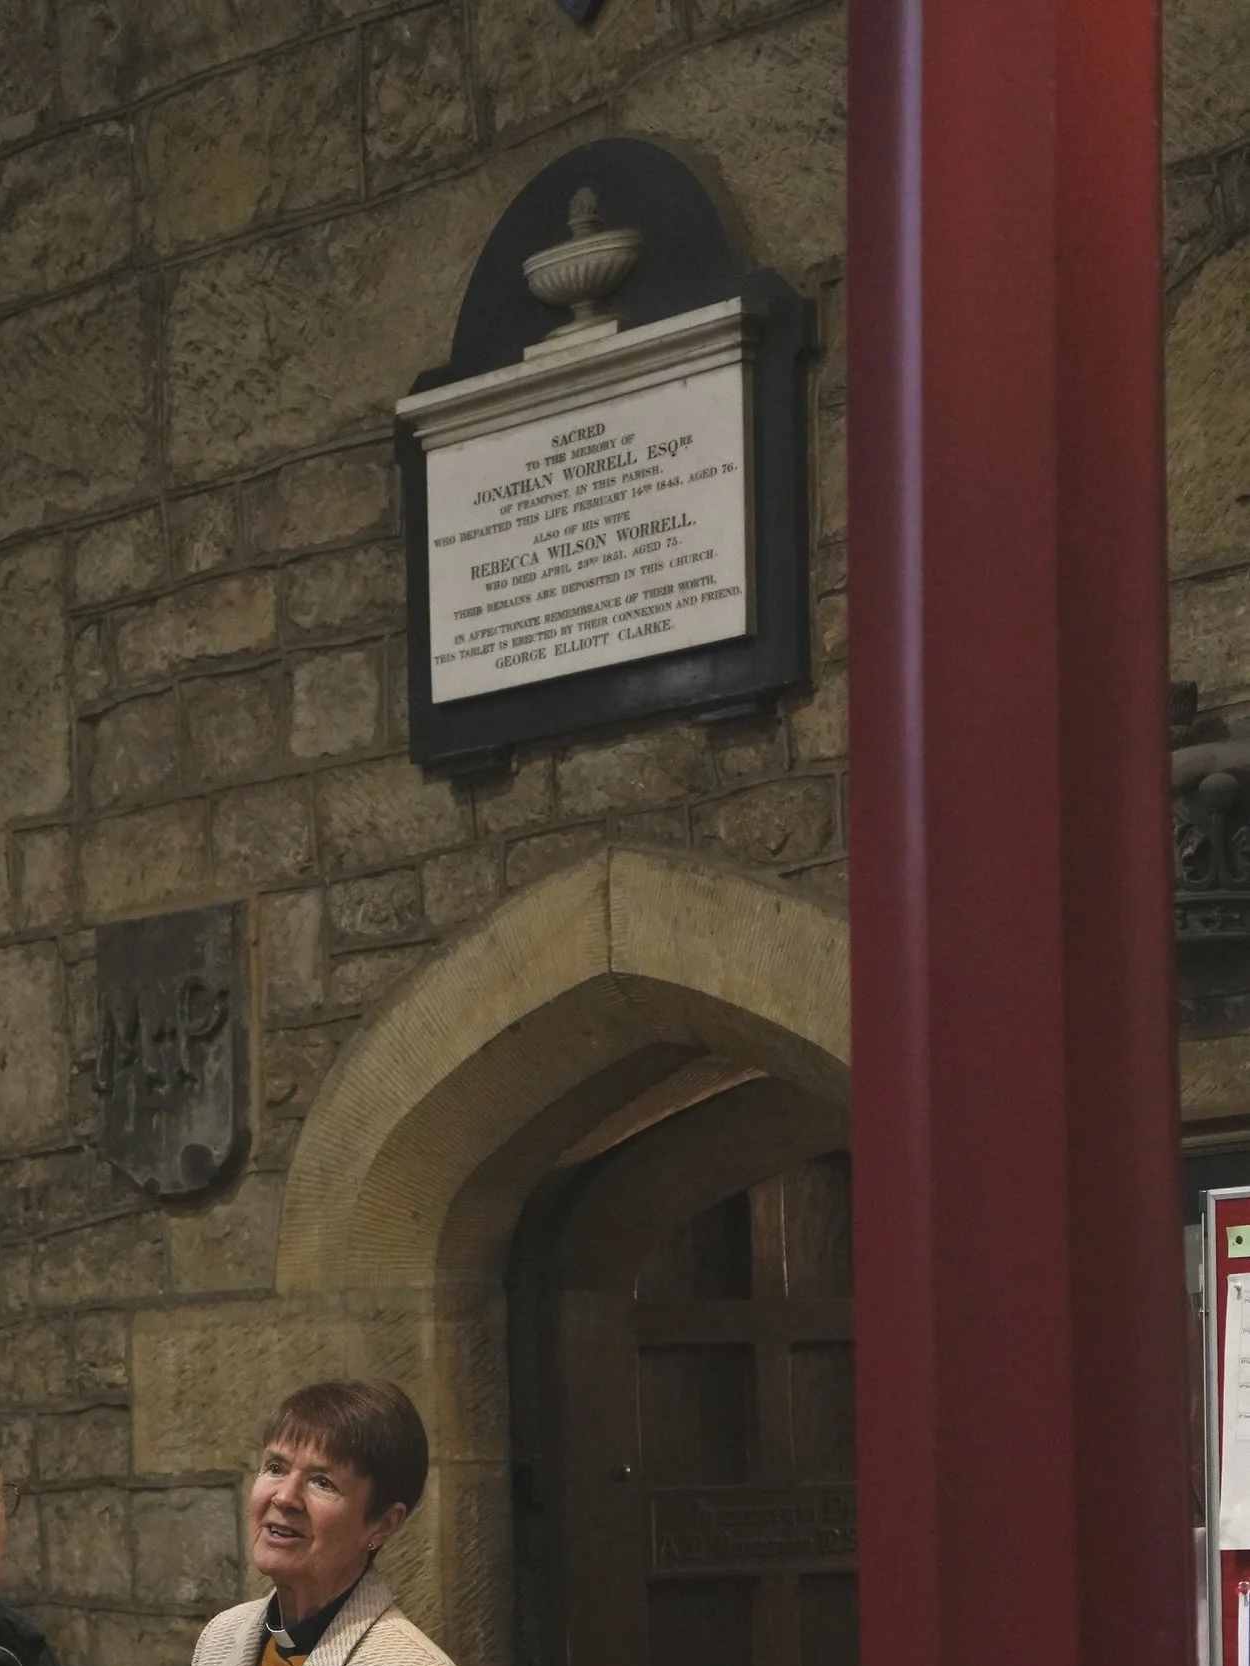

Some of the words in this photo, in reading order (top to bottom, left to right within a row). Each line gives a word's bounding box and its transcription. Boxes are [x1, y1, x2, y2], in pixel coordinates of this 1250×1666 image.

[525, 460, 540, 472] TO
[544, 452, 567, 467] THE
[571, 438, 617, 459] MEMORY
[621, 433, 635, 445] OF
[551, 423, 606, 448] SACRED
[473, 472, 553, 506] JONATHAN
[562, 451, 638, 481] WORRELL
[499, 503, 514, 515] OF
[575, 483, 588, 496] IN
[592, 476, 617, 491] THIS
[621, 465, 664, 484] PARISH.
[433, 536, 456, 548] WHO
[459, 520, 512, 543] DEPARTED
[516, 513, 540, 528] THIS
[544, 506, 569, 521] LIFE
[573, 490, 627, 512] FEBRUARY
[687, 467, 718, 483] AGED
[533, 529, 560, 545] ALSO
[564, 524, 579, 536] OF
[581, 518, 600, 532] HIS
[604, 510, 631, 525] WIFE
[470, 551, 540, 580] REBECCA
[547, 533, 607, 560] WILSON
[485, 578, 508, 592] WHO
[512, 571, 536, 586] DIED
[541, 563, 572, 580] APRIL
[632, 540, 662, 557] AGED
[453, 605, 483, 620] THEIR
[487, 593, 532, 613] REMAINS
[536, 587, 557, 601] ARE
[561, 571, 620, 595] DEPOSITED
[624, 567, 636, 580] IN
[640, 560, 665, 575] THIS
[669, 548, 718, 569] CHURCH.
[434, 653, 456, 666] THIS
[459, 642, 495, 659] TABLET
[498, 640, 509, 650] IS
[511, 628, 557, 648] ERECTED
[560, 625, 574, 637] BY
[577, 616, 608, 634] THEIR
[612, 600, 673, 624] CONNEXION
[675, 595, 698, 609] AND
[454, 633, 466, 645] IN
[468, 616, 541, 642] AFFECTIONATE
[544, 596, 622, 624] REMEMBRANCE
[625, 592, 638, 604] OF
[642, 584, 674, 600] THEIR
[495, 647, 547, 670] GEORGE
[554, 633, 609, 657] ELLIOTT
